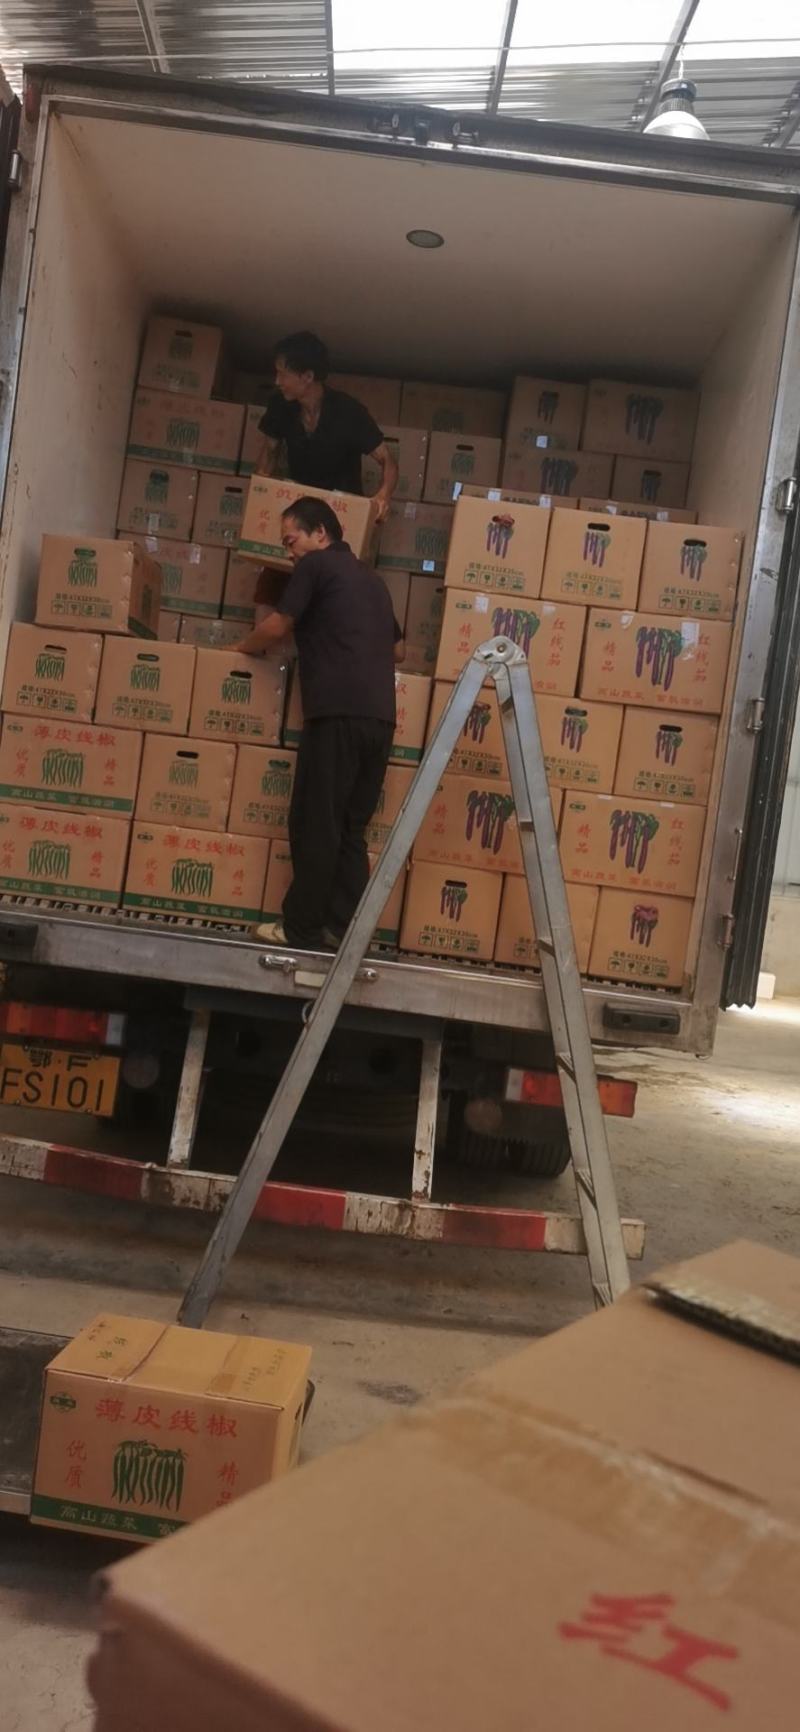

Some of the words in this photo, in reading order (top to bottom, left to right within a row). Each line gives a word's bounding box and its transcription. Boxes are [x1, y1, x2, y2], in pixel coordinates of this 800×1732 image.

[0, 1067, 105, 1112] FS101
[96, 1397, 239, 1439] 薄皮线椒
[65, 1439, 87, 1489] 优质
[60, 1504, 138, 1531] 高山蔬菜
[557, 1592, 739, 1713] 红
